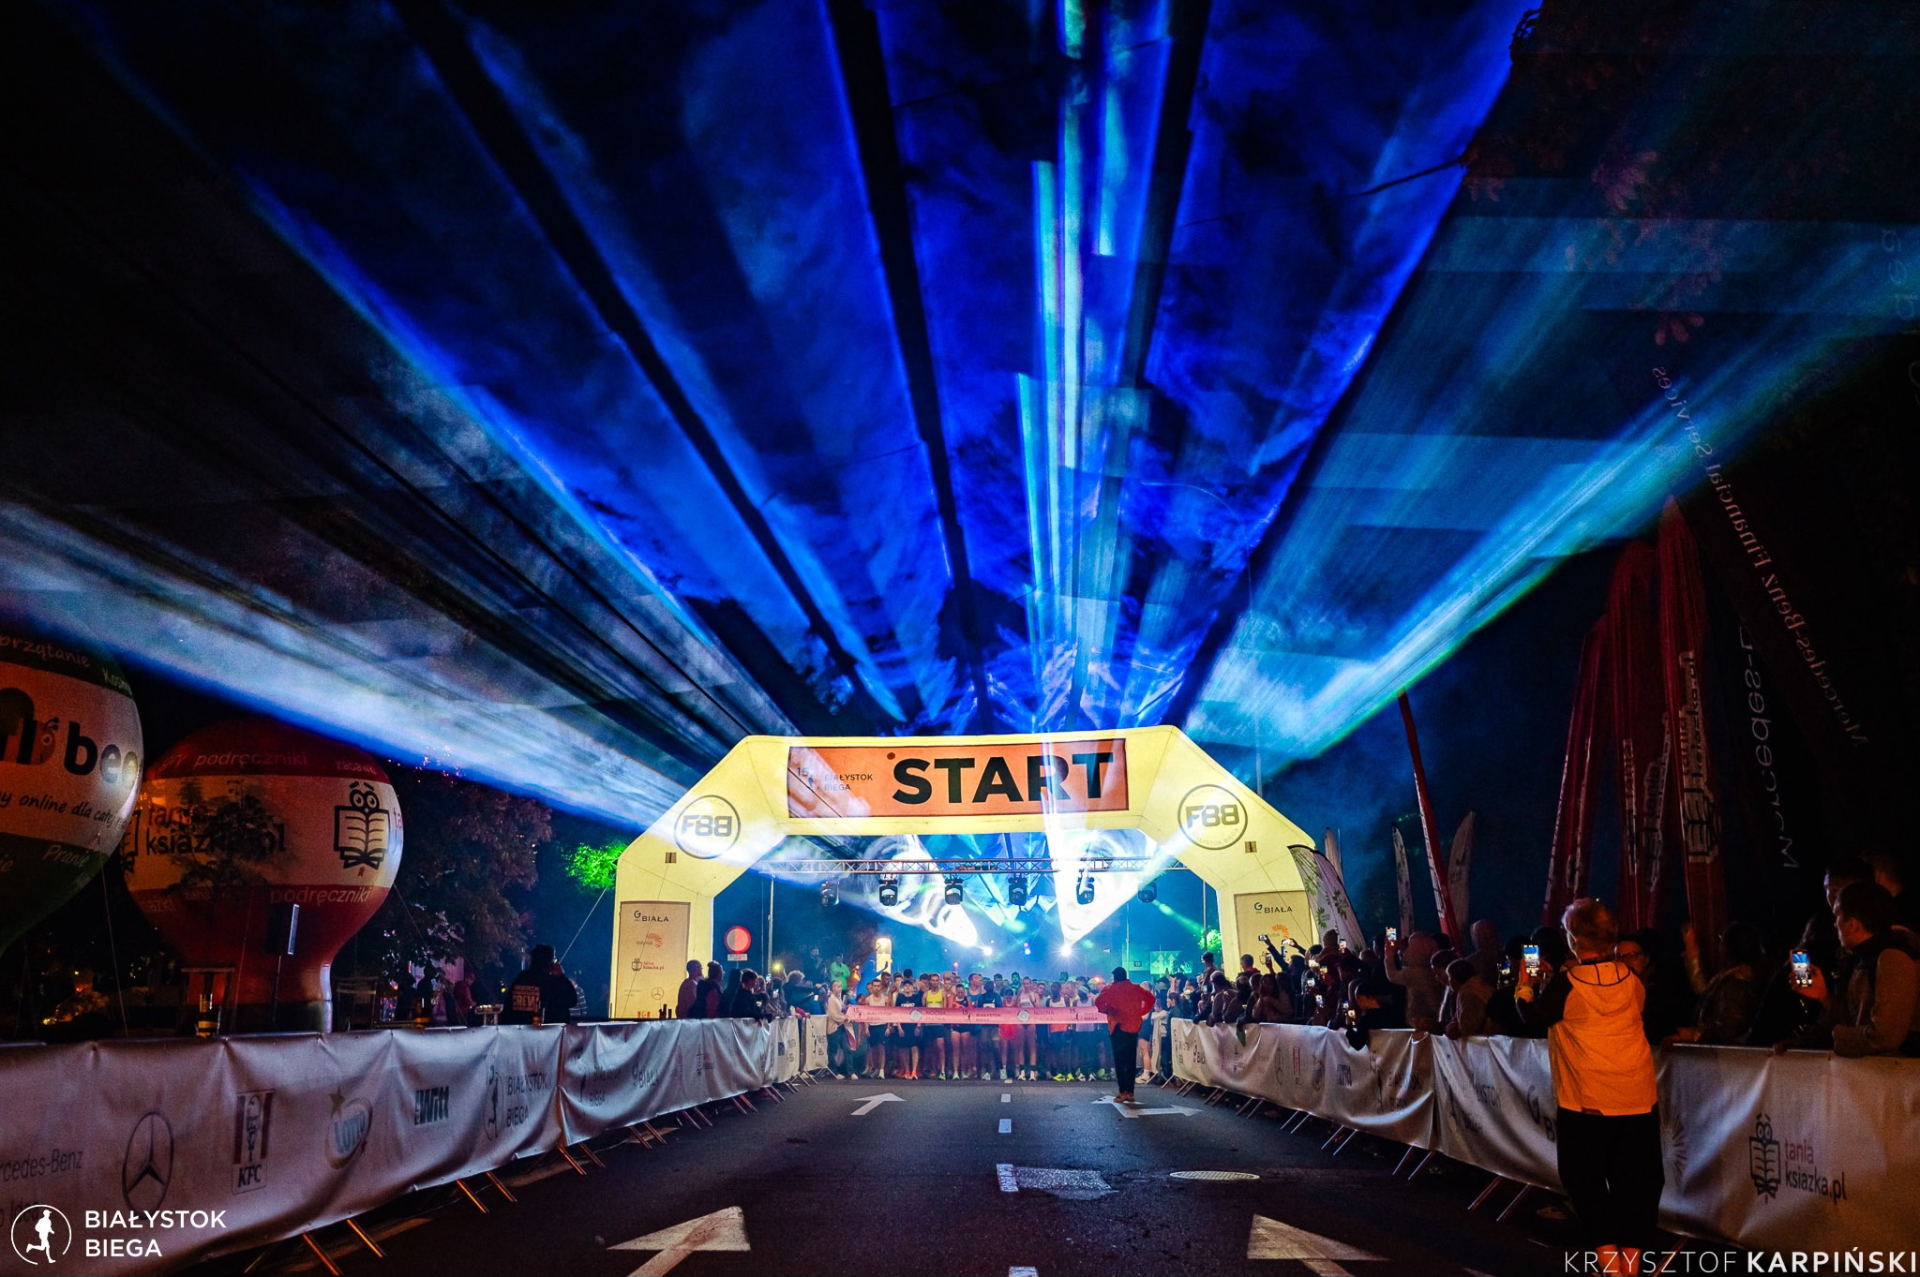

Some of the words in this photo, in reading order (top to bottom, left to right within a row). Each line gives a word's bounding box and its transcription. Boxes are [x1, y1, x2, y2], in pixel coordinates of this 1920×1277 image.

[192, 750, 309, 771] podręczniki
[892, 752, 1114, 804] START
[19, 793, 68, 813] online
[71, 801, 92, 819] dla
[1186, 803, 1240, 829] F88
[681, 815, 733, 837] F88
[270, 886, 374, 909] podręczniki
[1264, 906, 1293, 914] BIAŁA
[1784, 1138, 1814, 1165] tania
[237, 1164, 262, 1188] KFC
[1784, 1161, 1848, 1206] ksiazka.pl
